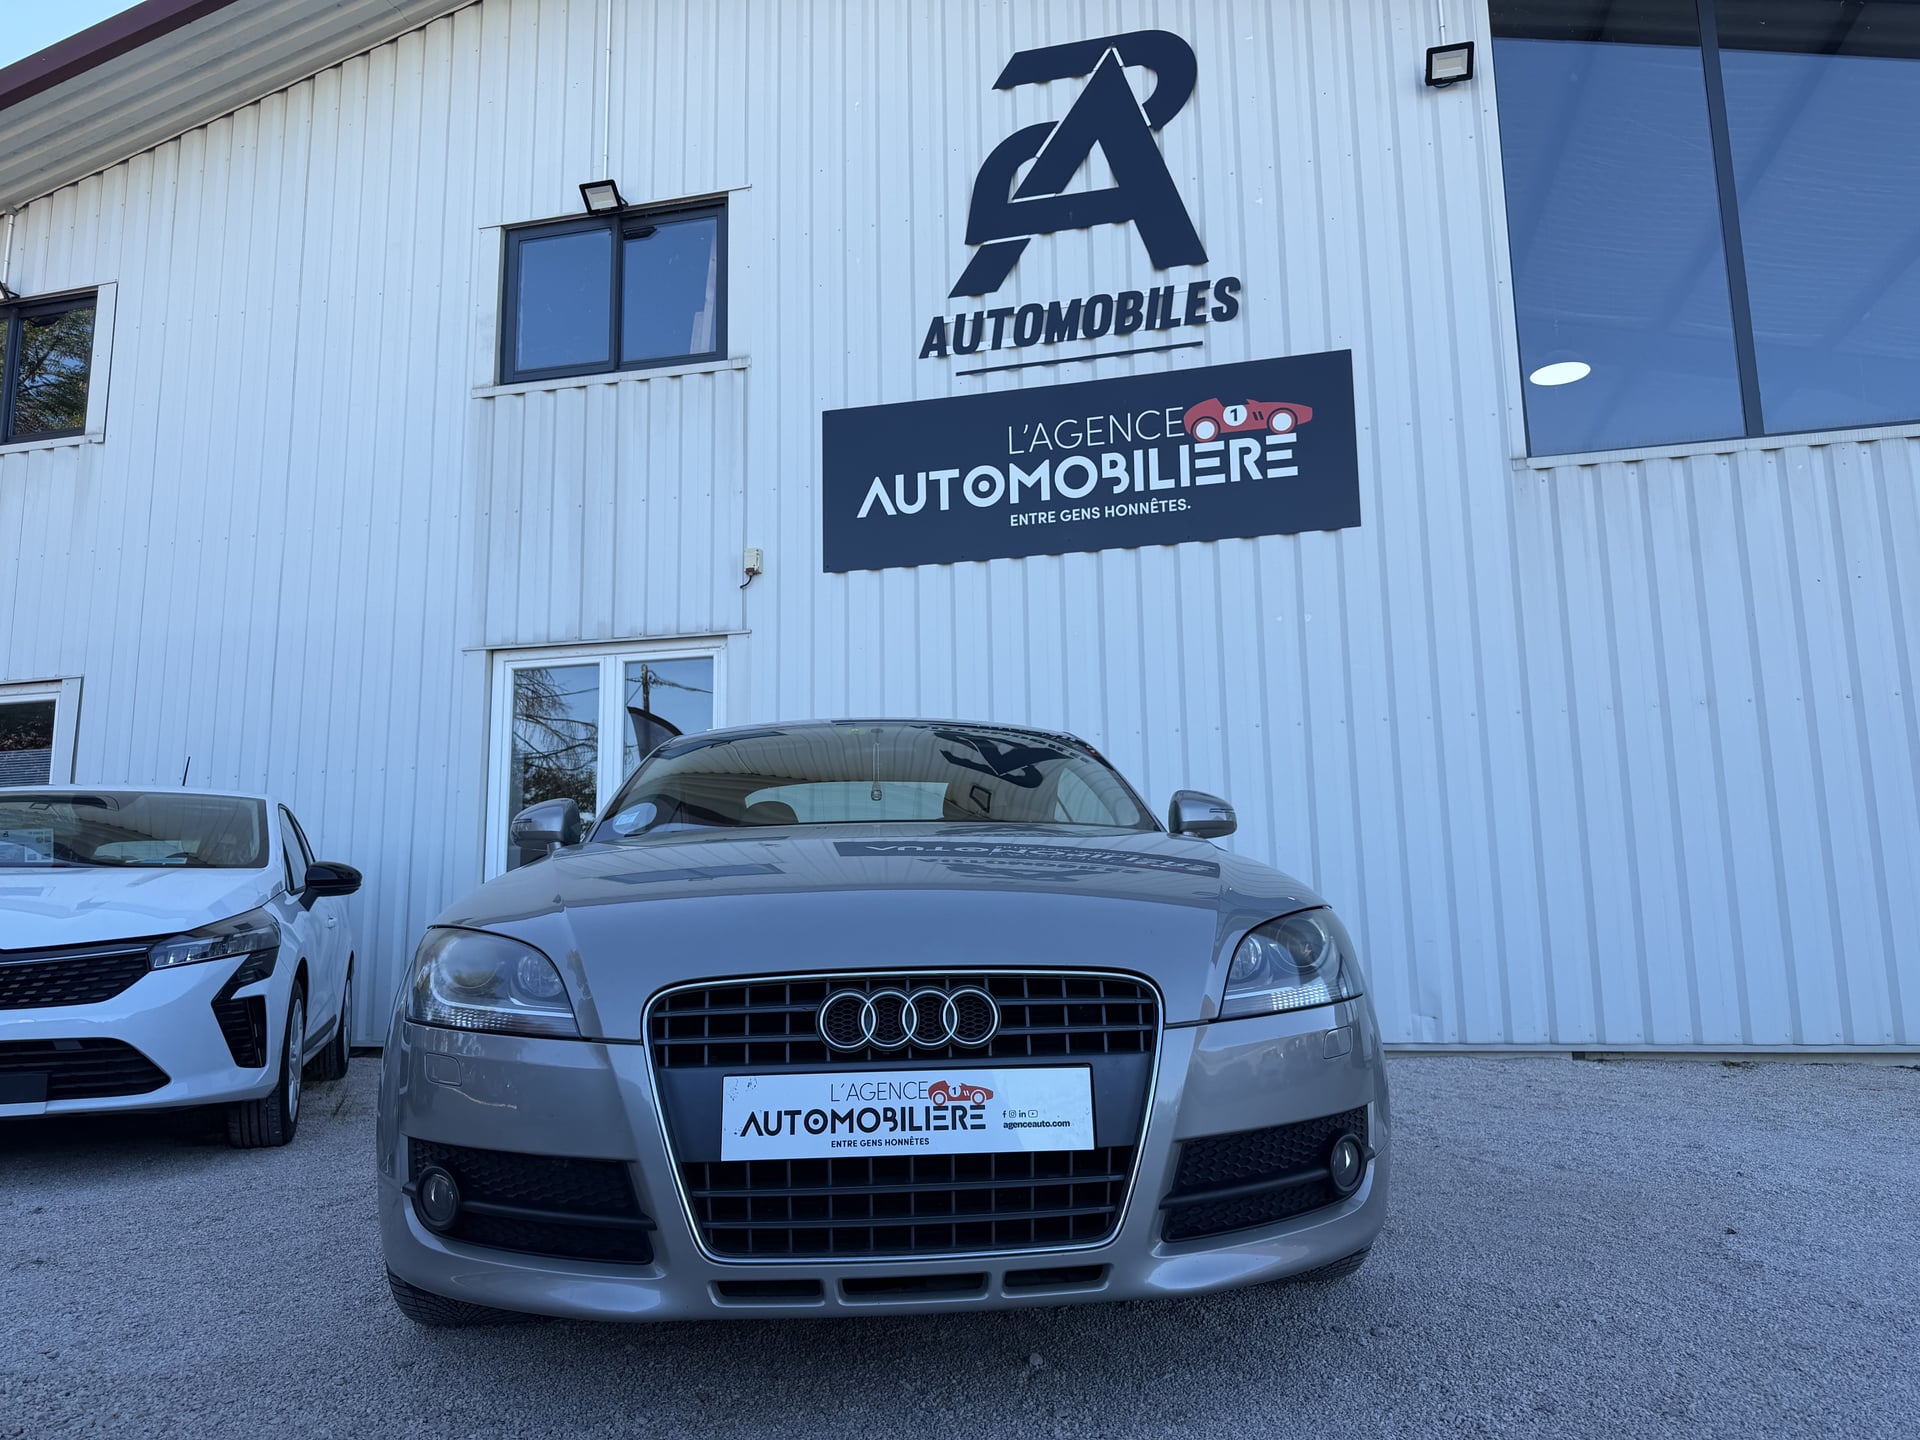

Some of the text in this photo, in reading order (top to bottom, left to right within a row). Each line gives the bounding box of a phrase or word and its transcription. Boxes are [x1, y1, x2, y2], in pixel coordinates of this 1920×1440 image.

[919, 277, 1241, 359] AUTOMOBILES
[1008, 407, 1185, 455] L'AGENCE
[856, 432, 1298, 519] AUTOMOBILIERE
[1010, 498, 1192, 527] ENTRE GENS HONNÊTES.
[830, 1080, 928, 1102] L'AGENCE
[740, 1105, 986, 1137] AUTOMOBILIERE
[1003, 1120, 1070, 1129] agenceauto.com
[831, 1136, 930, 1148] ENTRE GENS HONNÊTES
